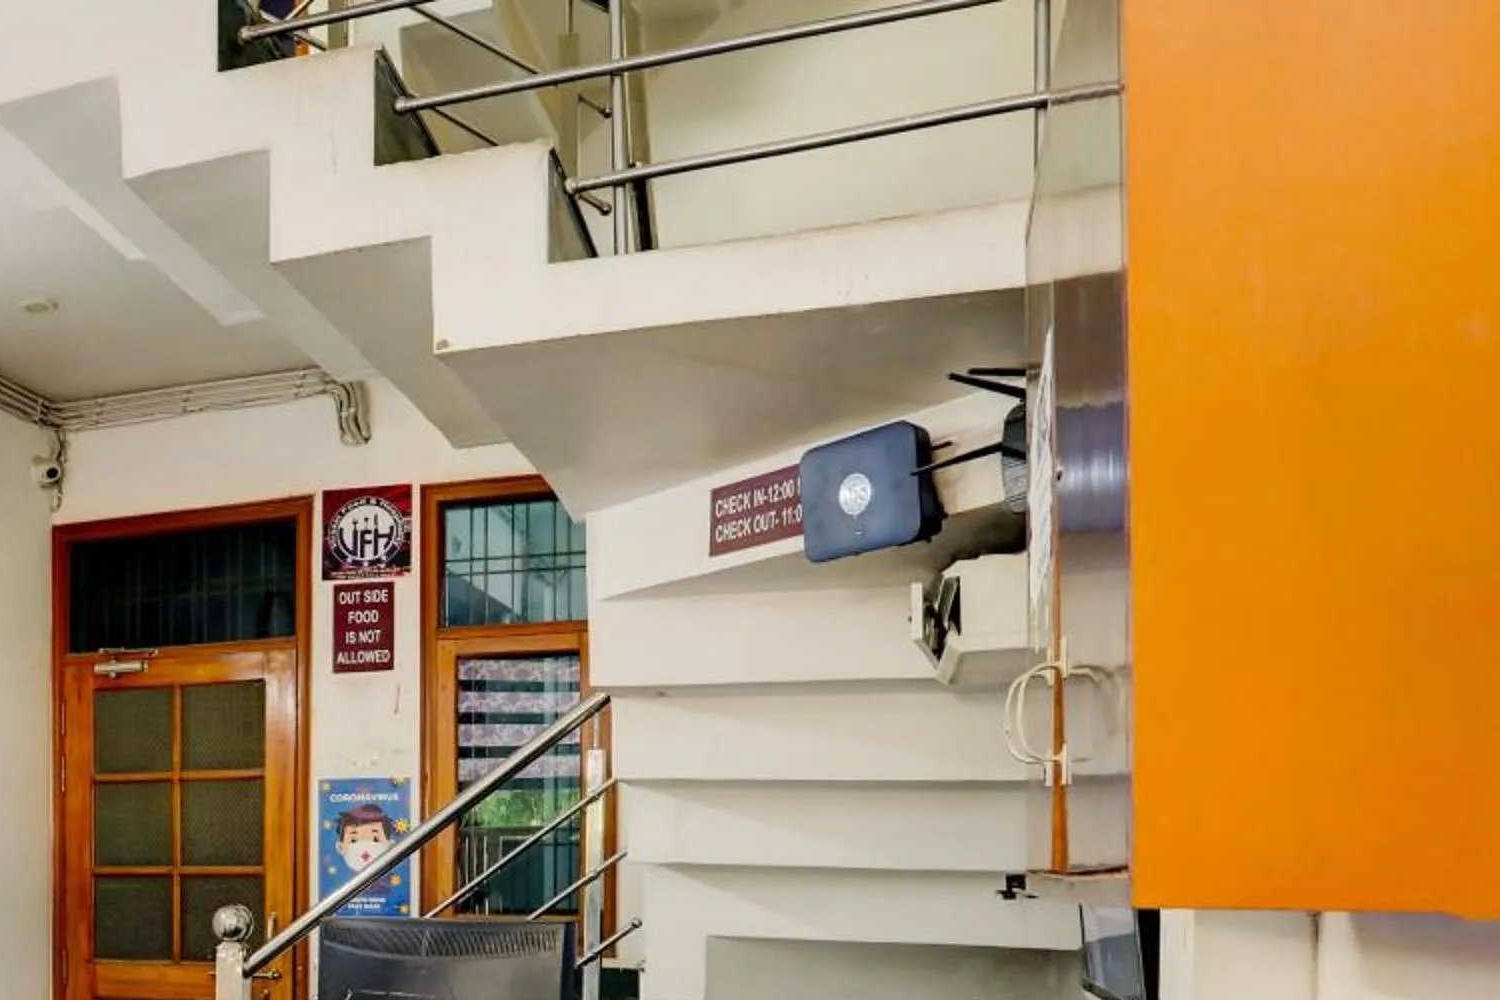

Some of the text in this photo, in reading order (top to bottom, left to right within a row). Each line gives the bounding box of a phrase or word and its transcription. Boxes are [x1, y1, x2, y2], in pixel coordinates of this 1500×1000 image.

[715, 491, 751, 518] CHECK
[715, 516, 751, 543] CHECK
[782, 503, 803, 528] 11:0
[339, 590, 389, 605] OUT SIDE
[347, 610, 380, 624] FOOD
[345, 630, 381, 644] IS NOT
[337, 650, 391, 665] ALLOWED
